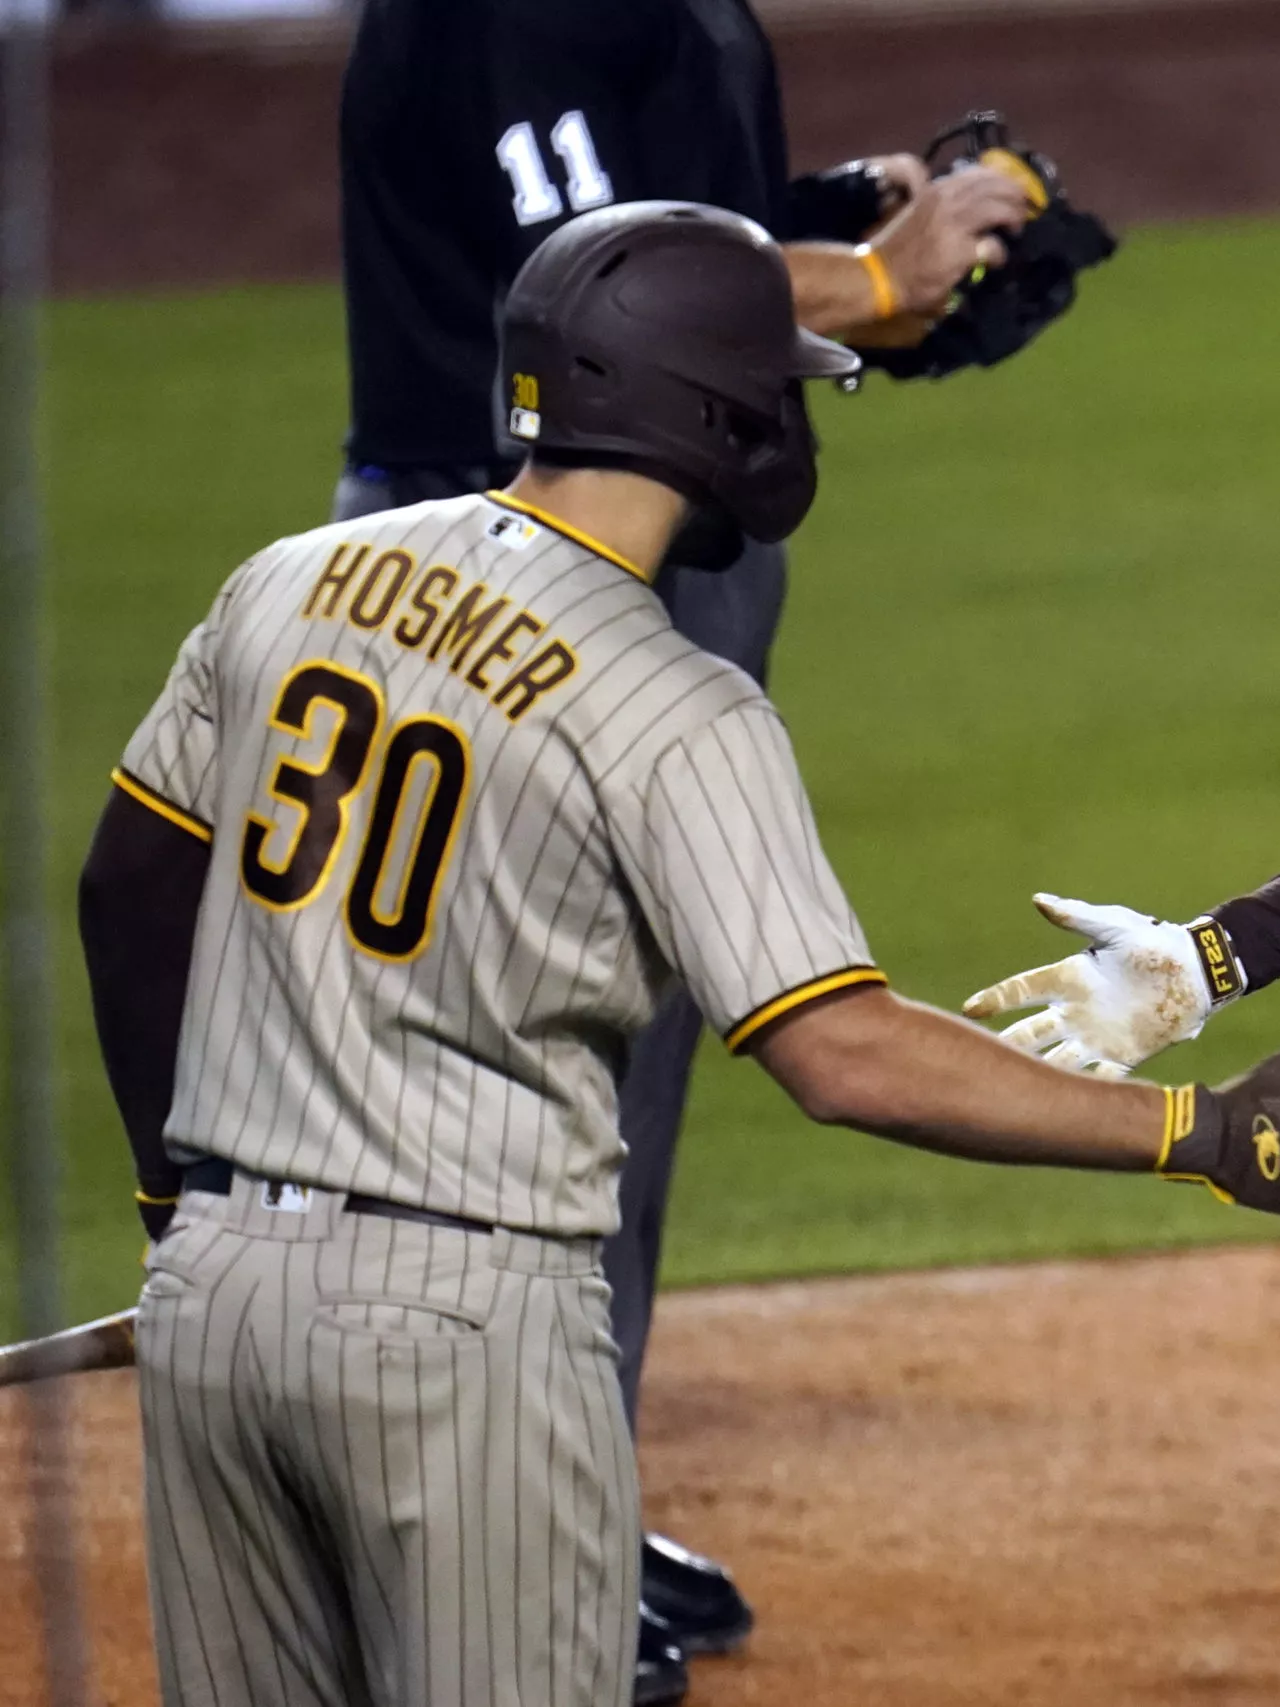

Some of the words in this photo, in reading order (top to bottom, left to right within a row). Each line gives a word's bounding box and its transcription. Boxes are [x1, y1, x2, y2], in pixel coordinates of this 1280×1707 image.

[495, 109, 614, 227] 11
[512, 372, 539, 410] 30
[302, 543, 579, 726] HOSMER
[239, 658, 473, 965] 30
[1199, 928, 1233, 993] FT23
